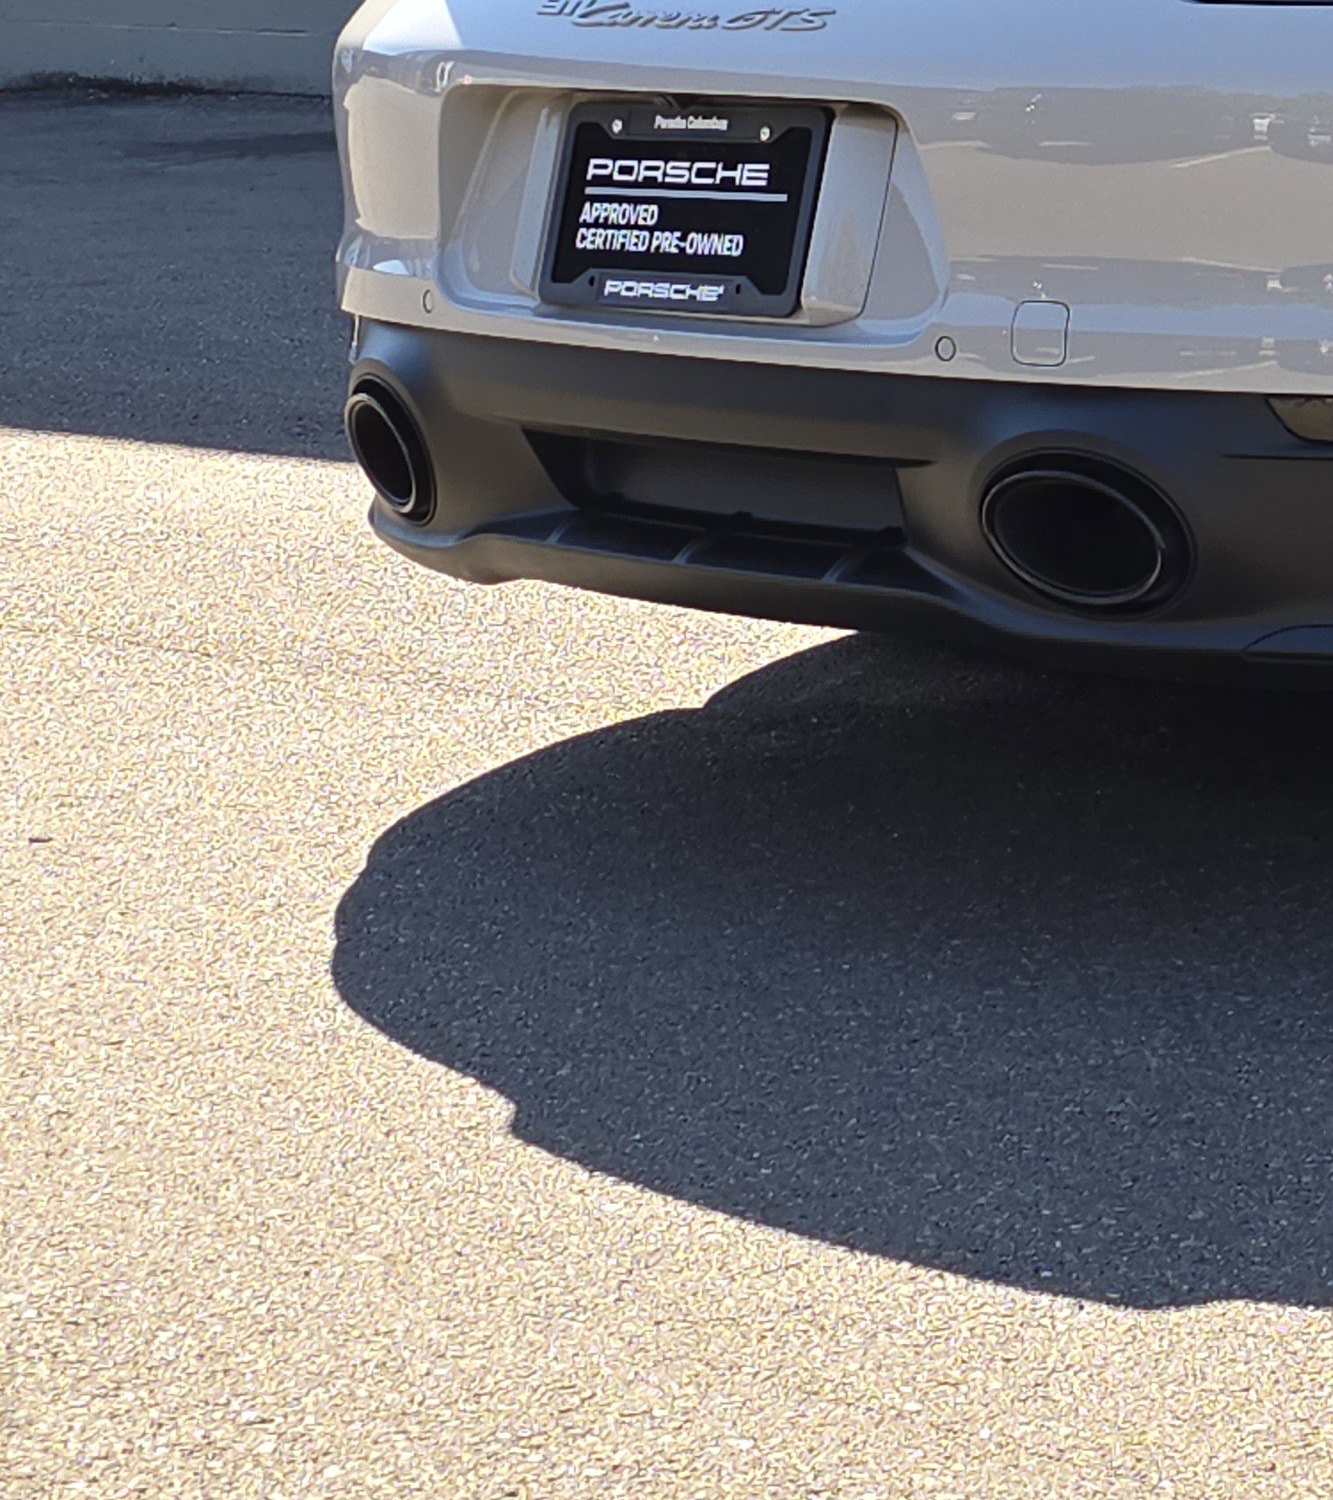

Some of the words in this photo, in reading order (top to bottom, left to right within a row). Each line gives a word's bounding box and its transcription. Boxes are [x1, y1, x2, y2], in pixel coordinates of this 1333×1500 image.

[721, 7, 836, 32] GTS
[587, 158, 770, 186] PORSCHE
[579, 202, 659, 226] APPROVED
[576, 228, 650, 251] CERTIFIED
[651, 231, 744, 257] PRE-OWNED
[604, 280, 721, 301] PORSCHE
